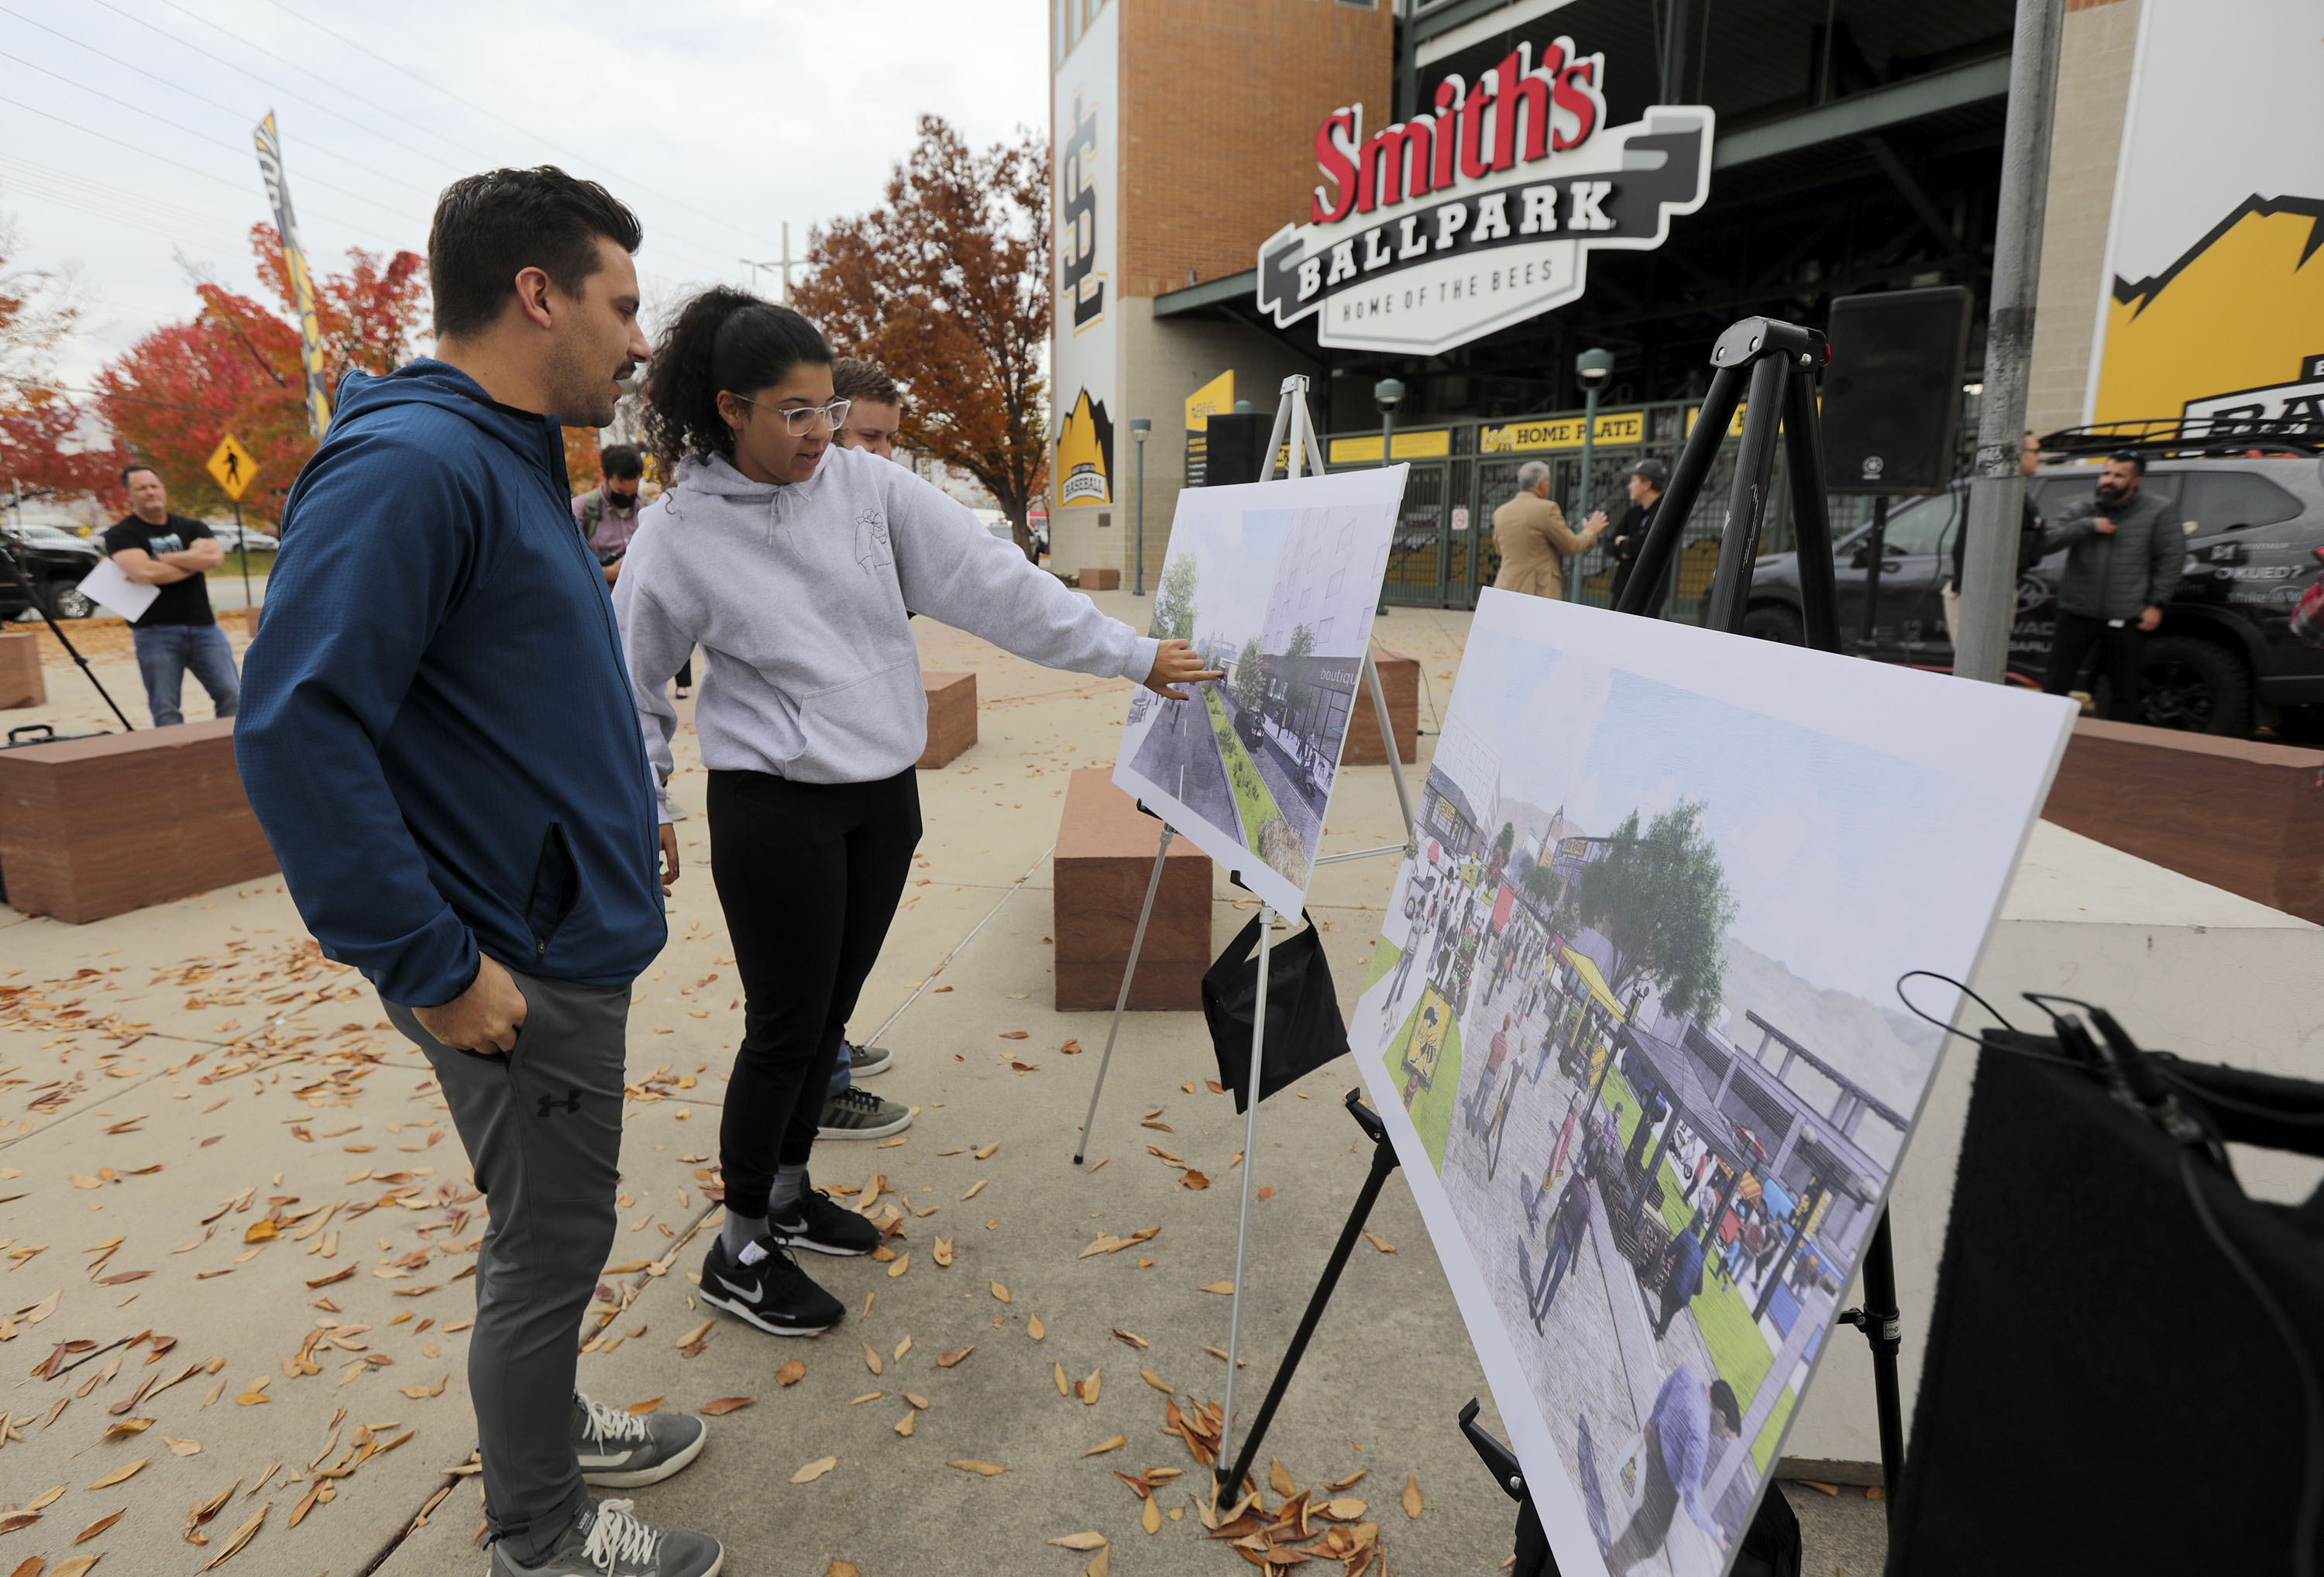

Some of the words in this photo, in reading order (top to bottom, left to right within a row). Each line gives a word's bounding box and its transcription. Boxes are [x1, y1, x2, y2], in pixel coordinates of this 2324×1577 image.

[1312, 40, 1599, 225] Smith's
[1297, 180, 1612, 303] BALLPARK
[1343, 294, 1393, 322] HOME
[1405, 287, 1427, 309] OF
[1439, 275, 1478, 303] THE
[1491, 260, 1552, 291] BEES
[1517, 426, 1570, 444] HOME
[1066, 477, 1103, 497] BASEBALL
